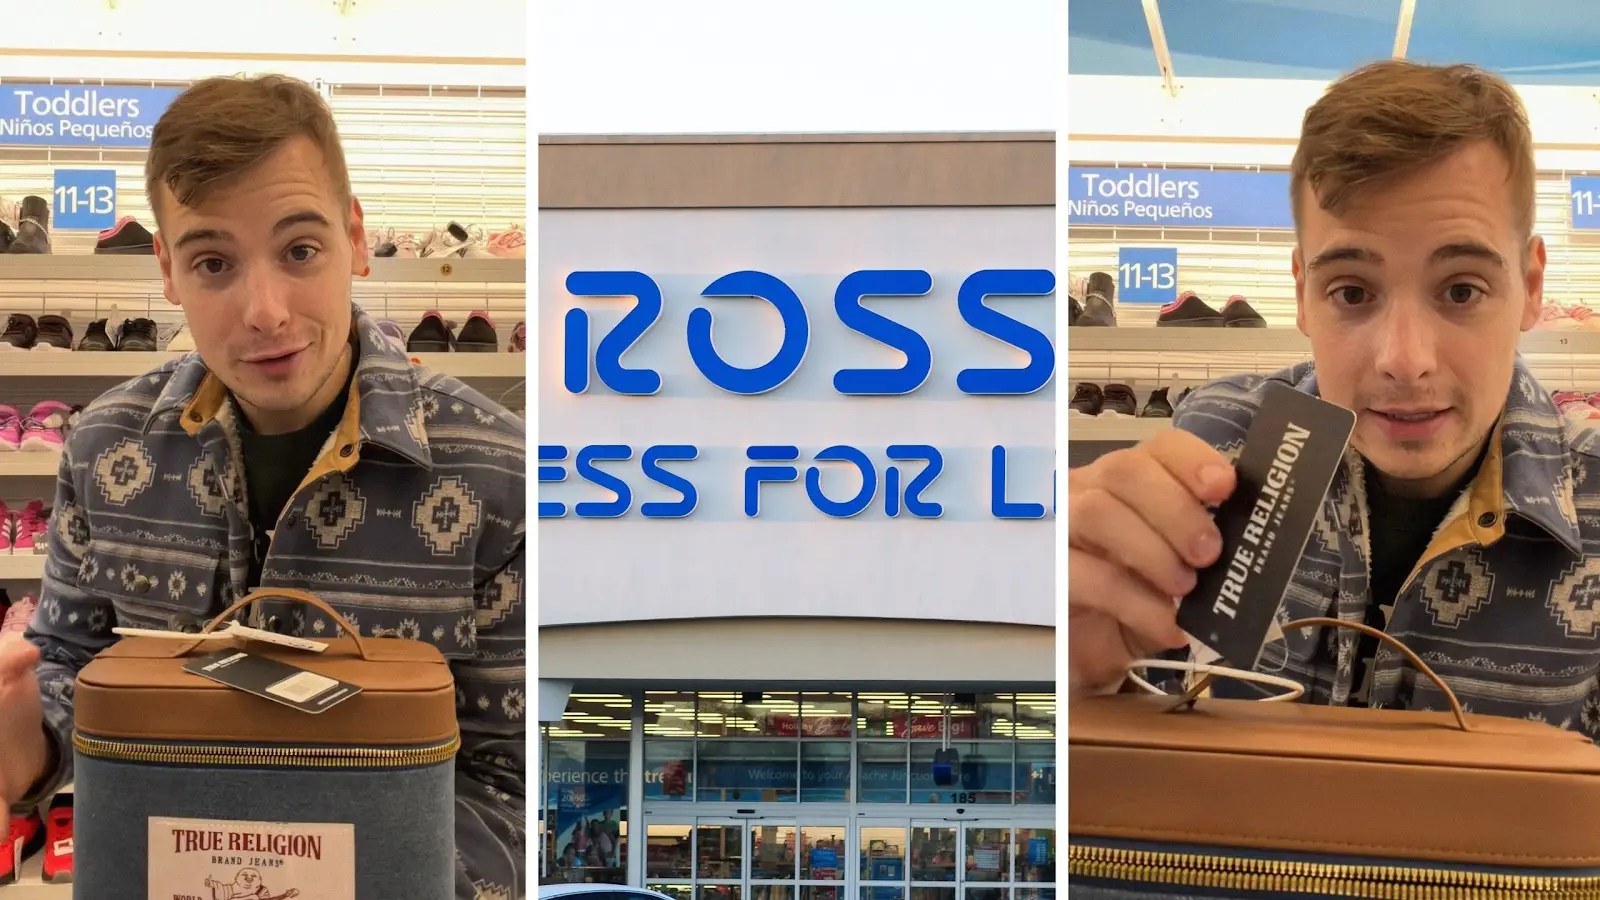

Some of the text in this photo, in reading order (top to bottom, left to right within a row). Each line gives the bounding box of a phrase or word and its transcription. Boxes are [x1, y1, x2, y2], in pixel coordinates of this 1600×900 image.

[13, 90, 140, 118] Toddlers
[0, 118, 153, 142] Niños Pequeños
[55, 185, 114, 214] 11-13
[1081, 173, 1199, 199] Toddlers
[1068, 199, 1213, 222] Niños Pequeños
[1572, 190, 1600, 216] 11-
[1119, 262, 1175, 289] 11-13
[564, 269, 1056, 395] ROSS
[744, 444, 944, 518] FOR
[991, 444, 1056, 518] L
[1213, 422, 1311, 619] TRUE RELIGION
[1253, 531, 1276, 575] BRAND
[938, 720, 965, 733] Bg!
[951, 792, 977, 804] 185
[172, 829, 321, 860] TRUE RELIGION
[211, 856, 242, 865] BRAND
